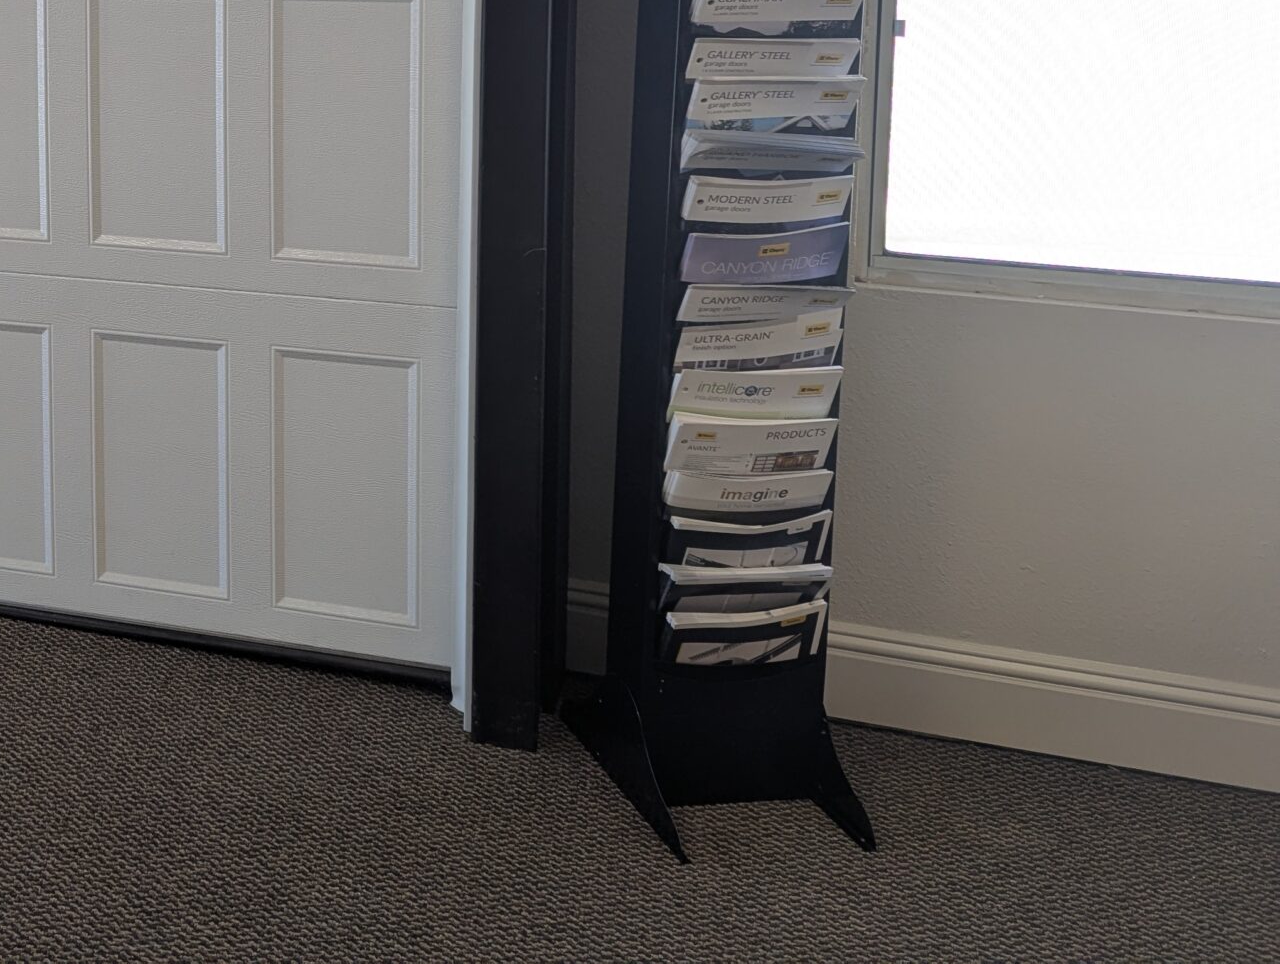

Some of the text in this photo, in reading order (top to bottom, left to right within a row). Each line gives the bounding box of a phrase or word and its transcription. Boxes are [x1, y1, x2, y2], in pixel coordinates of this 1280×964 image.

[707, 50, 792, 60] GALLERY STEEL
[710, 90, 795, 101] GALLERY STEEL
[708, 194, 794, 205] MODERN STEEL
[701, 252, 831, 275] CANYON RIDGE
[701, 295, 785, 305] CANYON RIDGE
[694, 332, 772, 344] ULTRA-GRAIN
[697, 381, 773, 397] intellicore
[766, 428, 827, 440] PRODUCTS
[720, 487, 789, 503] imagine
